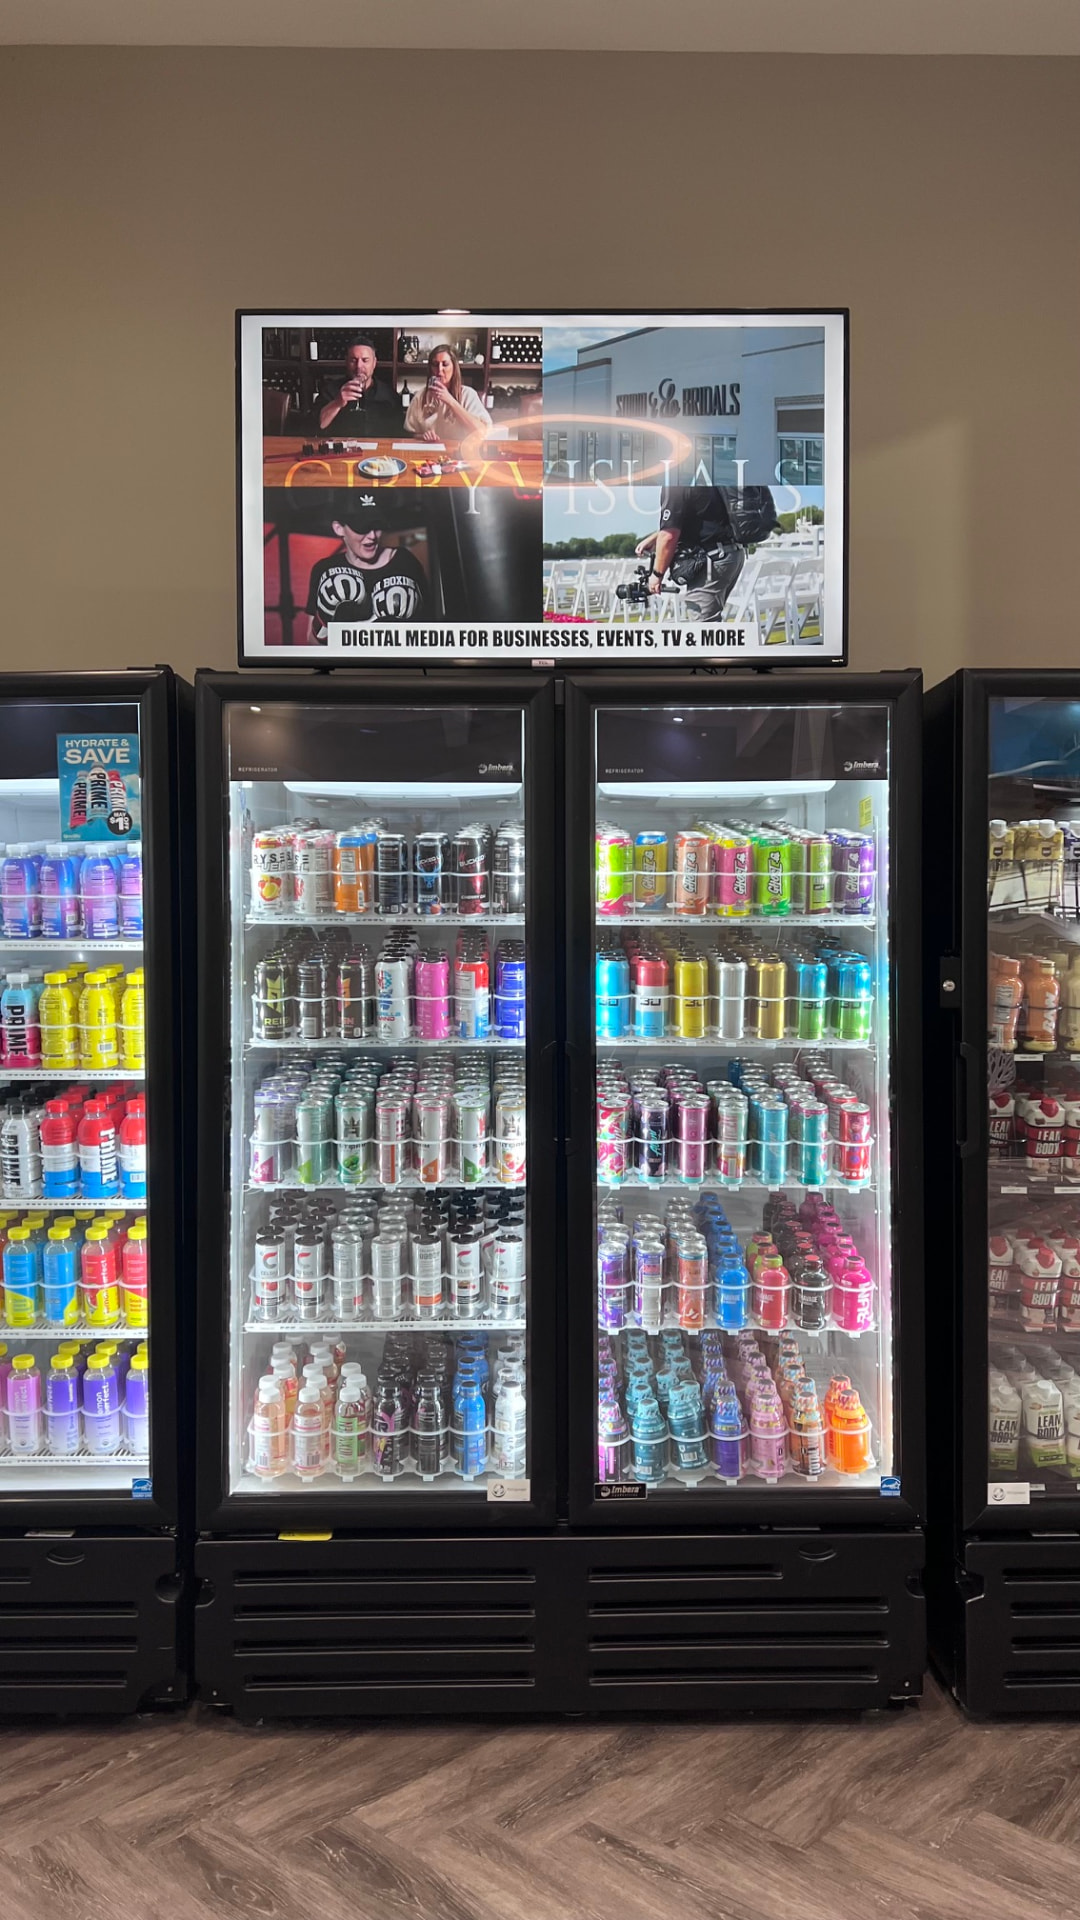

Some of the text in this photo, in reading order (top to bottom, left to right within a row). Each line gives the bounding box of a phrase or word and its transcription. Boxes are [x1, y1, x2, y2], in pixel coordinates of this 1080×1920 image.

[682, 383, 740, 416] BRIDALS
[341, 629, 745, 648] DIGITAL MEDIA FOR BUSINESSES, EVENTS, TV & MORE
[65, 739, 129, 748] HYDRATE &
[65, 748, 130, 764] SAVE
[73, 782, 87, 818] PRIME
[90, 772, 108, 809] PRIME
[109, 781, 127, 811] PRIM
[683, 857, 698, 894] GHOST
[733, 857, 748, 896] GHOST
[767, 858, 783, 895] GHOST
[6, 1005, 28, 1056] PRIME
[100, 1128, 118, 1184] PRIME
[1036, 1142, 1060, 1155] BODY
[994, 1420, 1018, 1432] LEAN
[1037, 1428, 1061, 1440] BODY
[1038, 1415, 1061, 1428] LEAN
